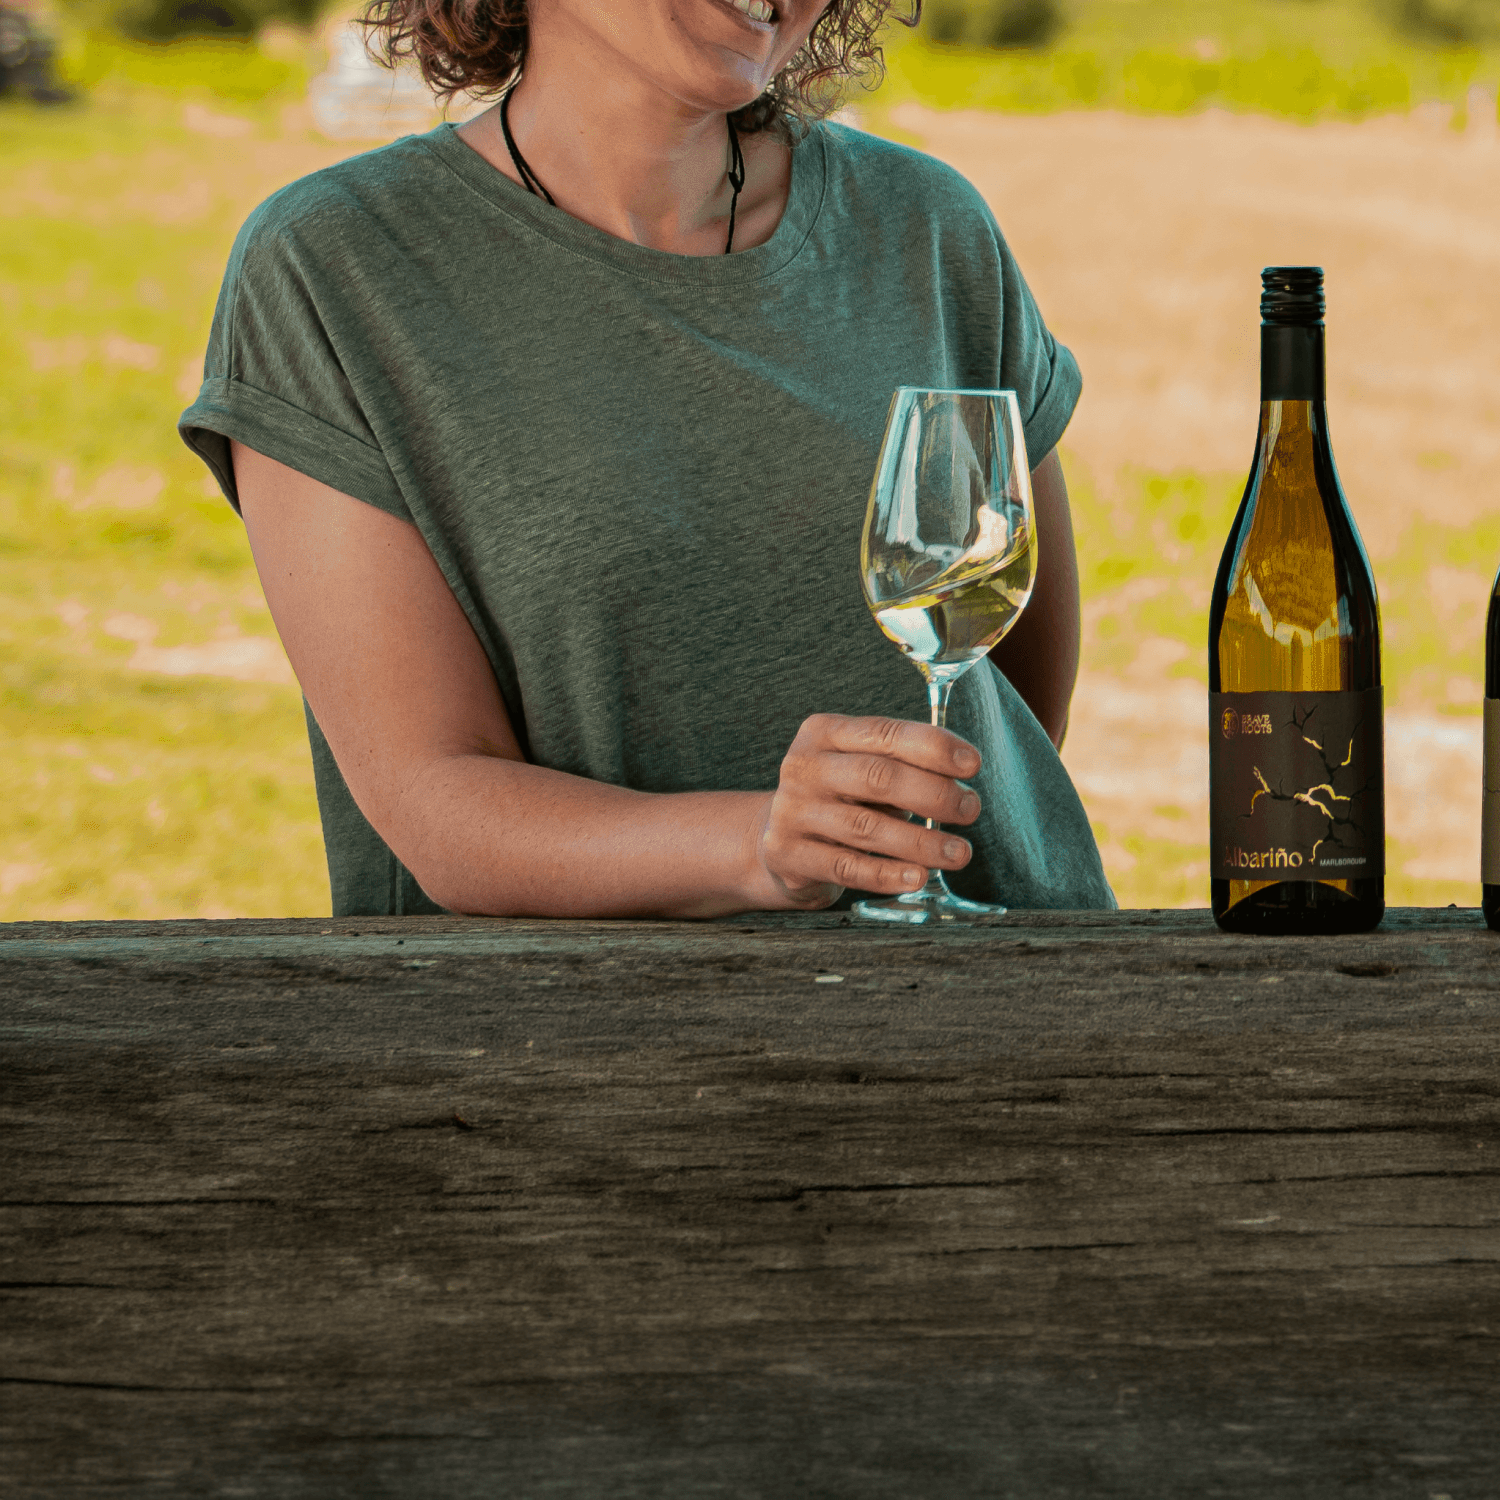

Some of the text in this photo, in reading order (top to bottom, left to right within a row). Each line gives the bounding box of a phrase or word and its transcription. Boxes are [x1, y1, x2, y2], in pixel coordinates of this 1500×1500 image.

[1241, 714, 1270, 724] BRAVE
[1241, 724, 1273, 734] ROOTS
[1223, 846, 1303, 868] Albariño
[1319, 857, 1367, 866] MARLBOROUGH
